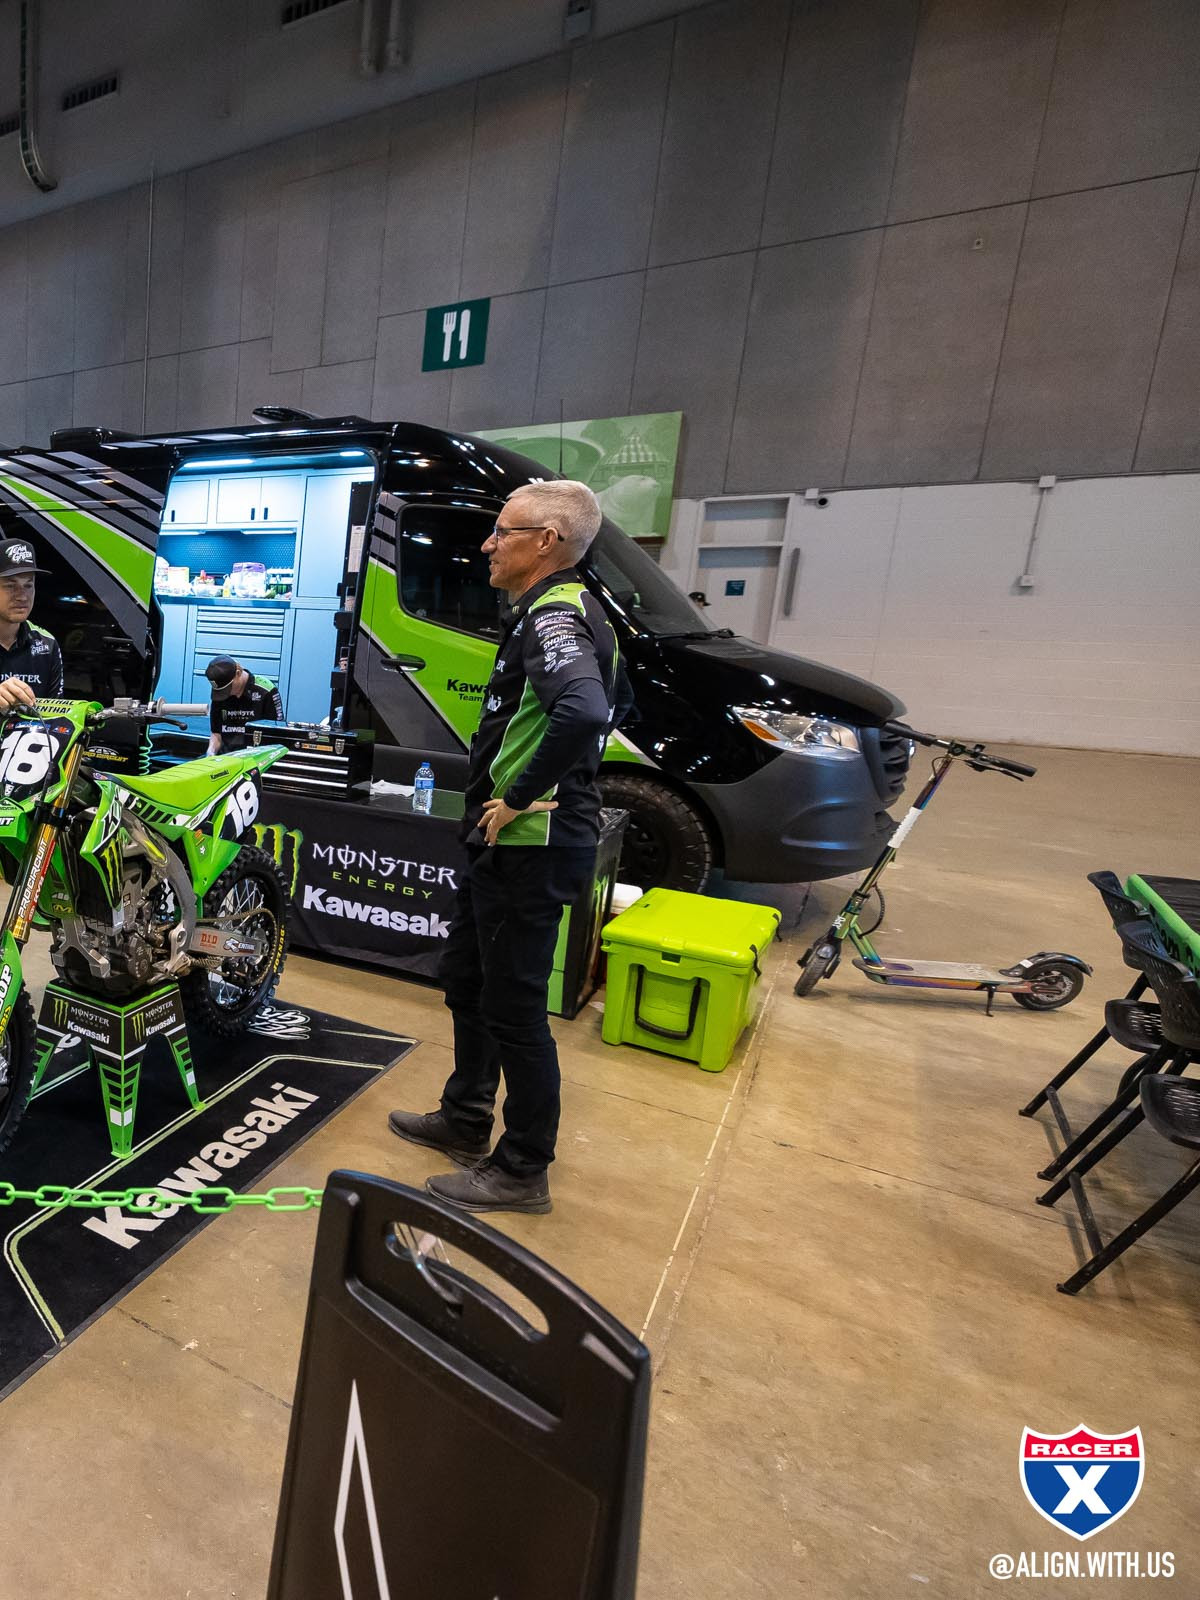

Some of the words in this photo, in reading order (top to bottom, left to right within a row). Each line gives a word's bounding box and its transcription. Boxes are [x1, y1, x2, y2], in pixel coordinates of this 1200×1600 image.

[226, 781, 259, 838] 18
[24, 838, 48, 892] CIRCUIT
[312, 842, 459, 891] MONSTER
[332, 871, 434, 899] ENERGY
[66, 1020, 110, 1045] Kawasaki
[70, 1006, 110, 1027] MONSTER
[145, 1013, 177, 1037] Kawasaki
[82, 1082, 320, 1250] Kawasaki
